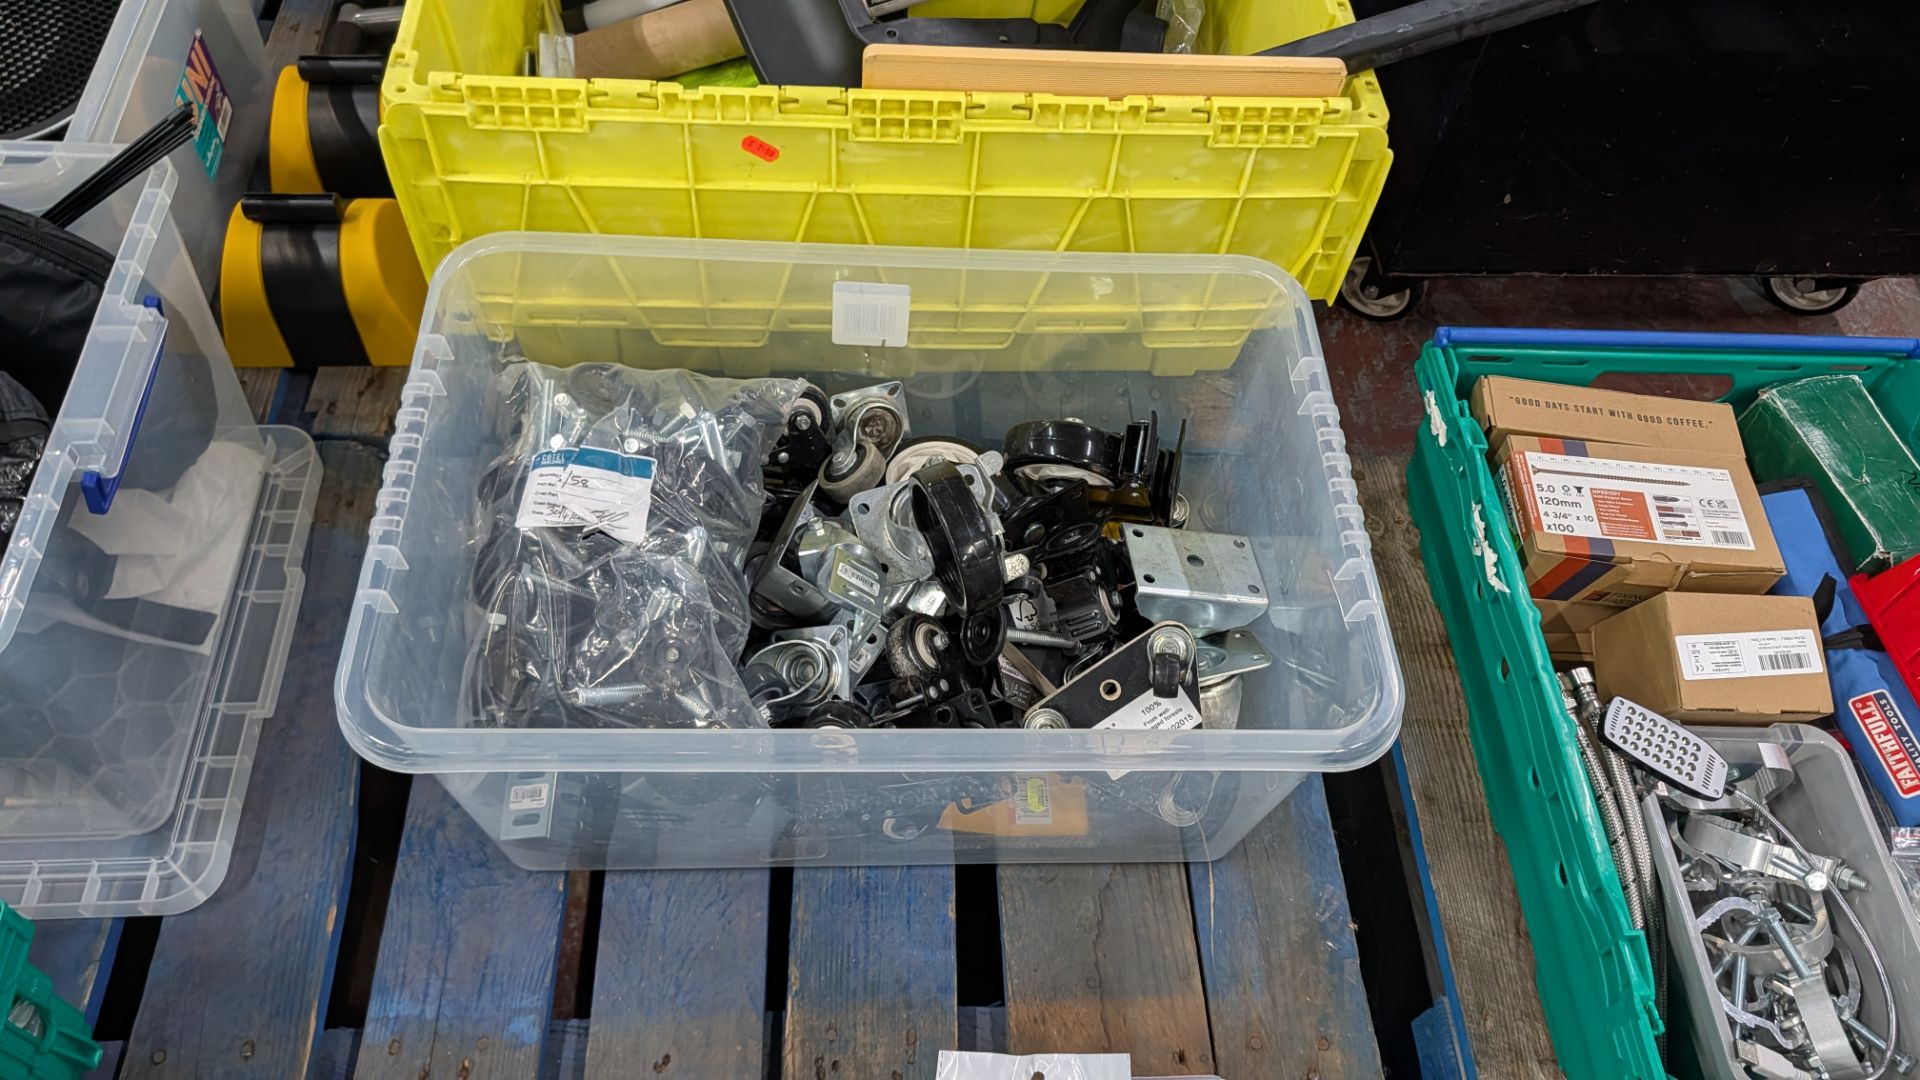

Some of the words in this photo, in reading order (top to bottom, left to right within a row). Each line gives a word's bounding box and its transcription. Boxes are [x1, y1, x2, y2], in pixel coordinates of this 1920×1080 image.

[1545, 400, 1570, 412] DAYS
[1574, 404, 1604, 416] START
[1608, 409, 1633, 421] WITH
[1637, 414, 1662, 425] GOOD
[1536, 483, 1556, 494] 5.0
[1539, 496, 1582, 509] 120mm
[1584, 515, 1595, 523] 10
[1546, 523, 1575, 534] x100
[1141, 699, 1163, 716] 100%
[1143, 715, 1158, 727] From
[1880, 699, 1902, 731] TOOLS
[1858, 700, 1920, 790] FAITHFULL
